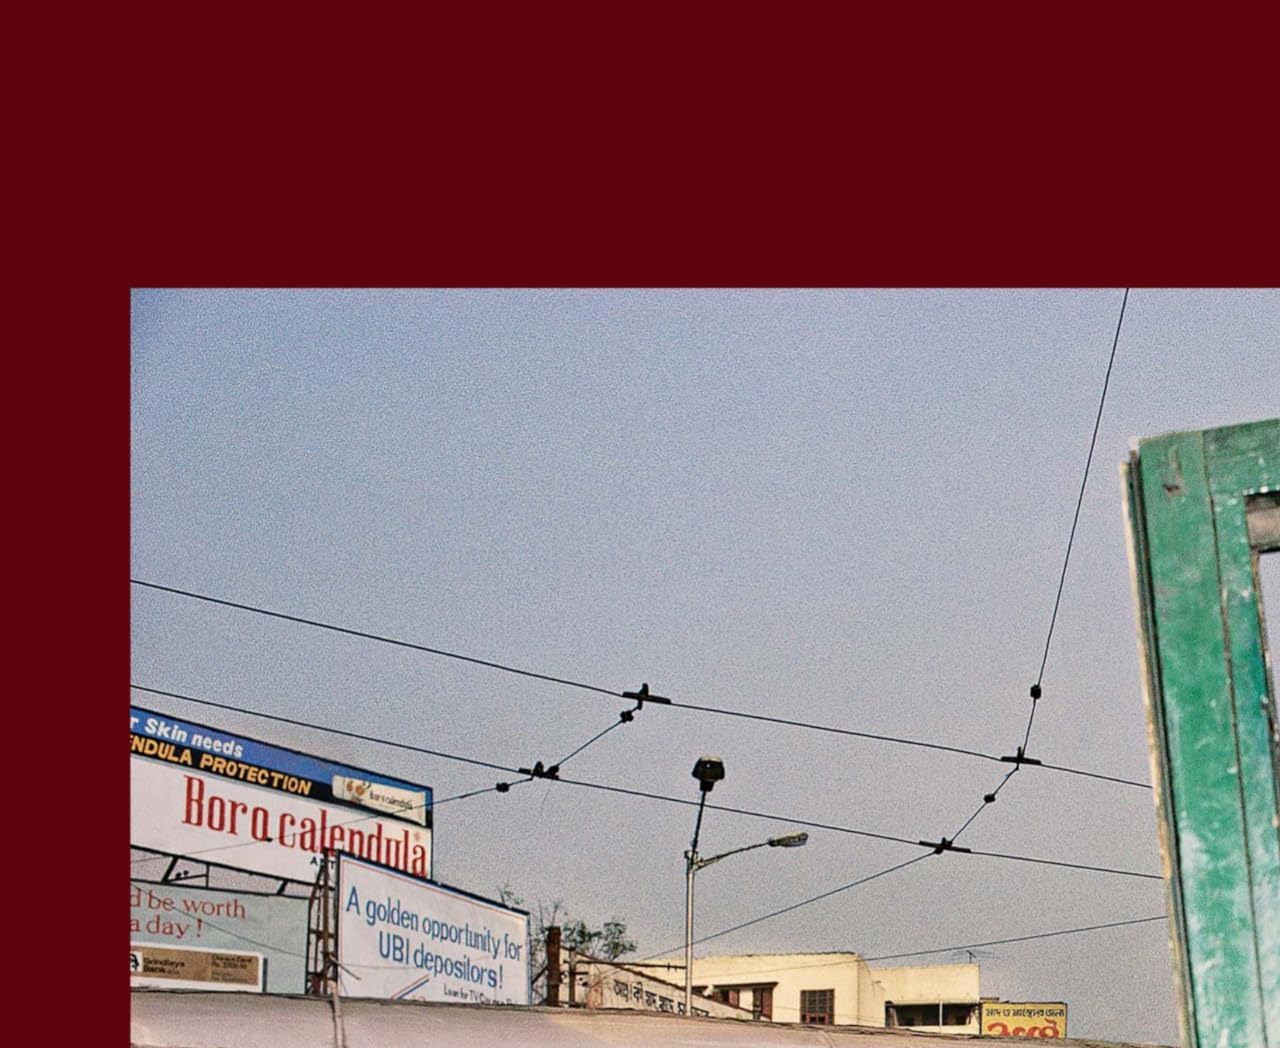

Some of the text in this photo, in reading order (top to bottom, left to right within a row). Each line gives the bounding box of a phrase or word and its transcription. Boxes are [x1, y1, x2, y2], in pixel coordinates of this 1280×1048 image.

[145, 717, 188, 743] Skin
[191, 733, 245, 758] needs
[130, 735, 312, 796] NDULA PROTECTION
[130, 918, 141, 932] a
[148, 889, 175, 911] be
[183, 897, 247, 919] worth
[346, 885, 523, 961] A golden opportunity for
[379, 931, 503, 990] UBI depositors!
